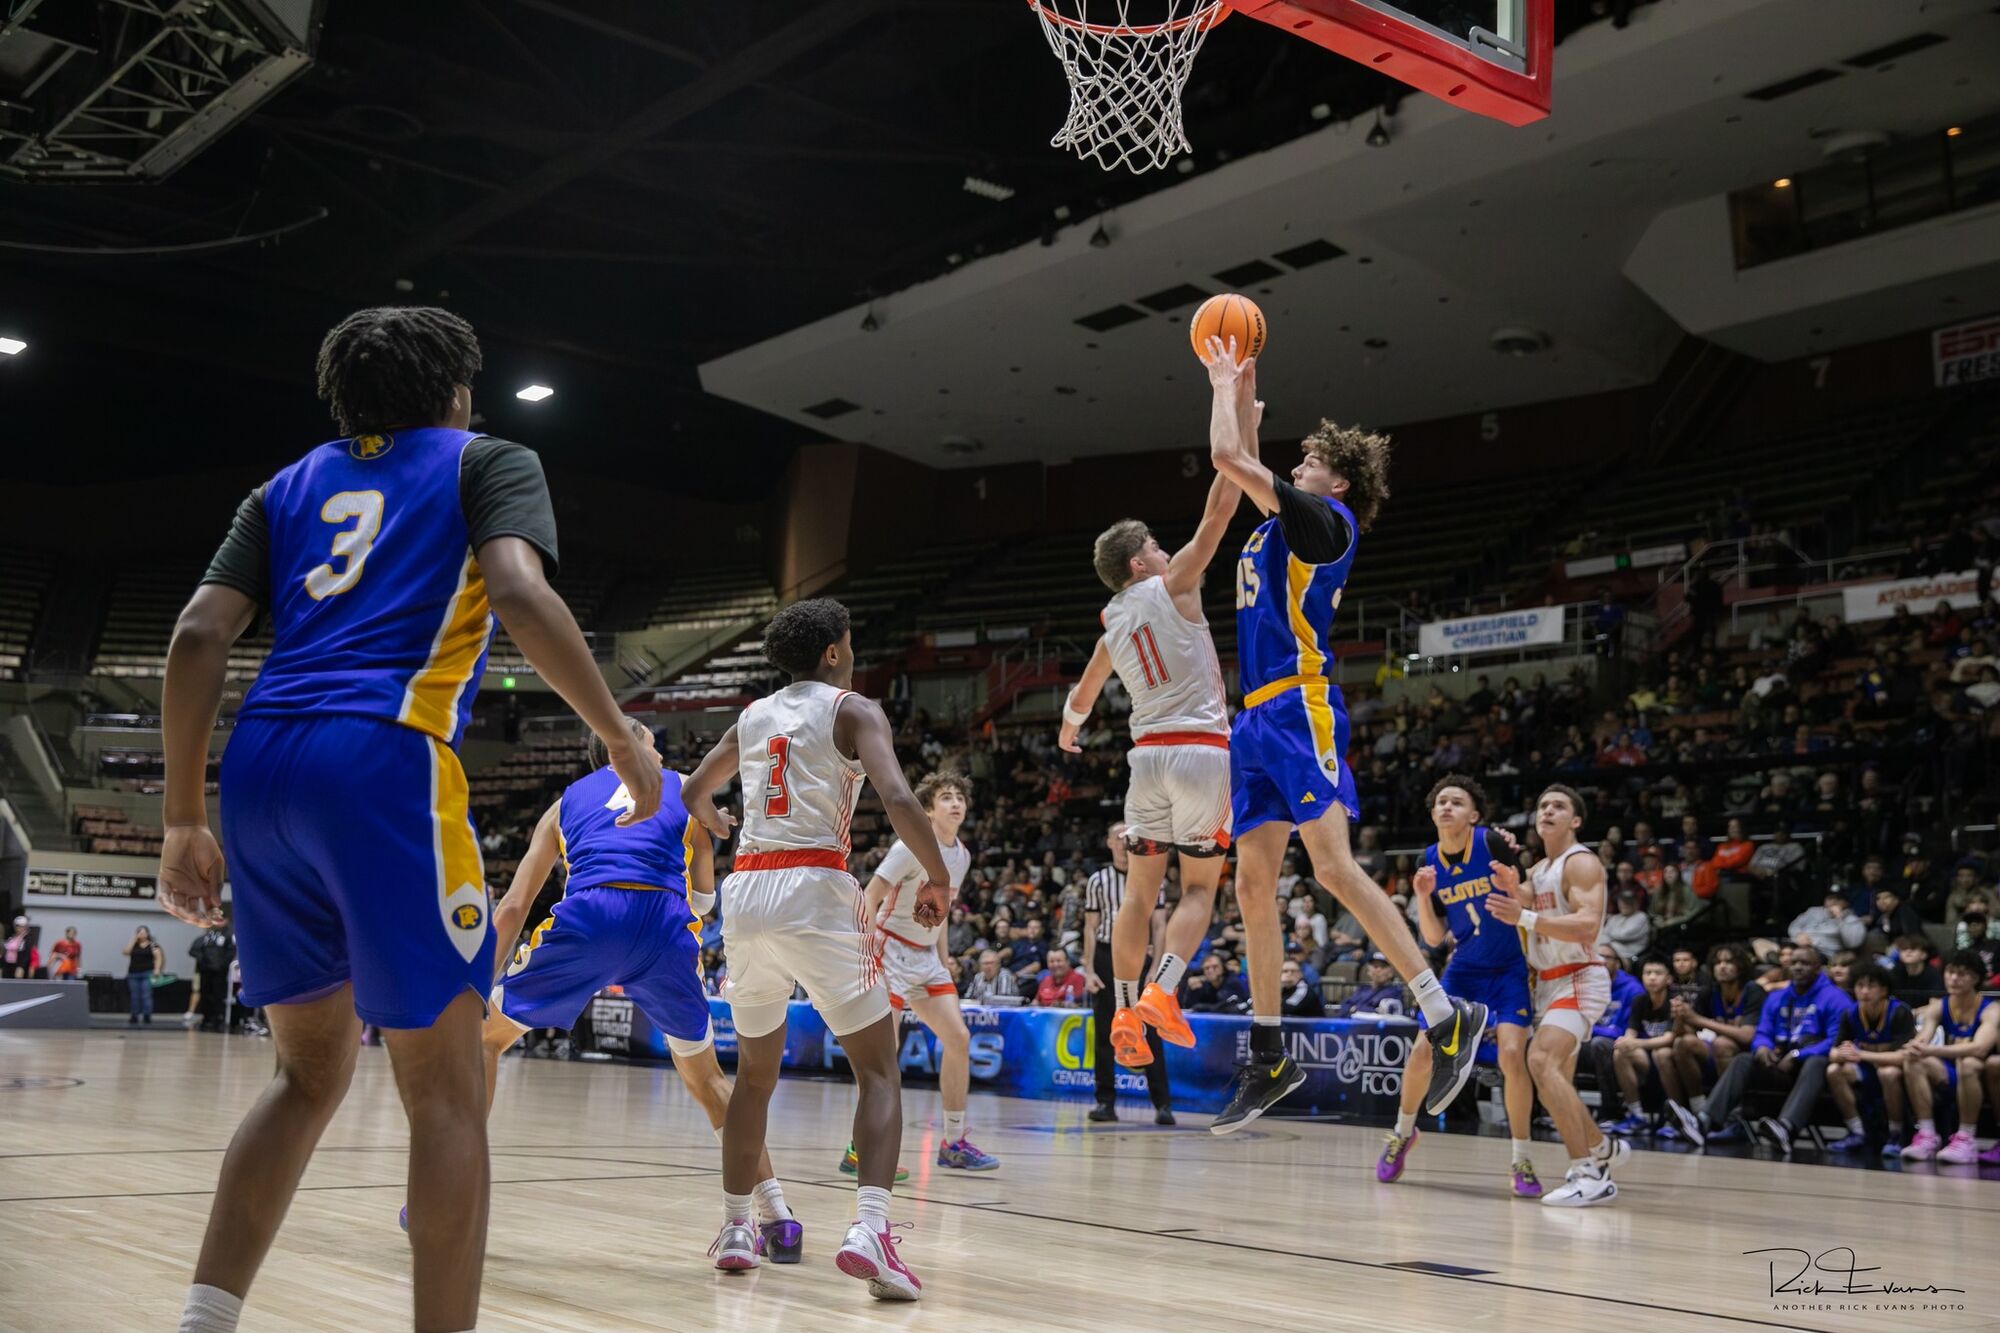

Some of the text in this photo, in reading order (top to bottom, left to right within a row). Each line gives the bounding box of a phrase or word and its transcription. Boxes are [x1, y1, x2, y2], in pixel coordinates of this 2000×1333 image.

[1808, 356, 1831, 388] 7
[1481, 413, 1499, 440] 5
[1181, 453, 1200, 478] 3
[973, 477, 987, 499] 1
[304, 489, 385, 601] 3
[1130, 622, 1171, 690] 11
[765, 733, 793, 819] 3
[1438, 876, 1493, 905] CLOVIS
[1465, 902, 1481, 937] 1
[592, 998, 634, 1022] ESPN
[592, 1020, 632, 1037] RADIO
[1236, 1030, 1248, 1060] THE
[1051, 1069, 1096, 1088] CENTRA
[1361, 1071, 1401, 1097] FCO
